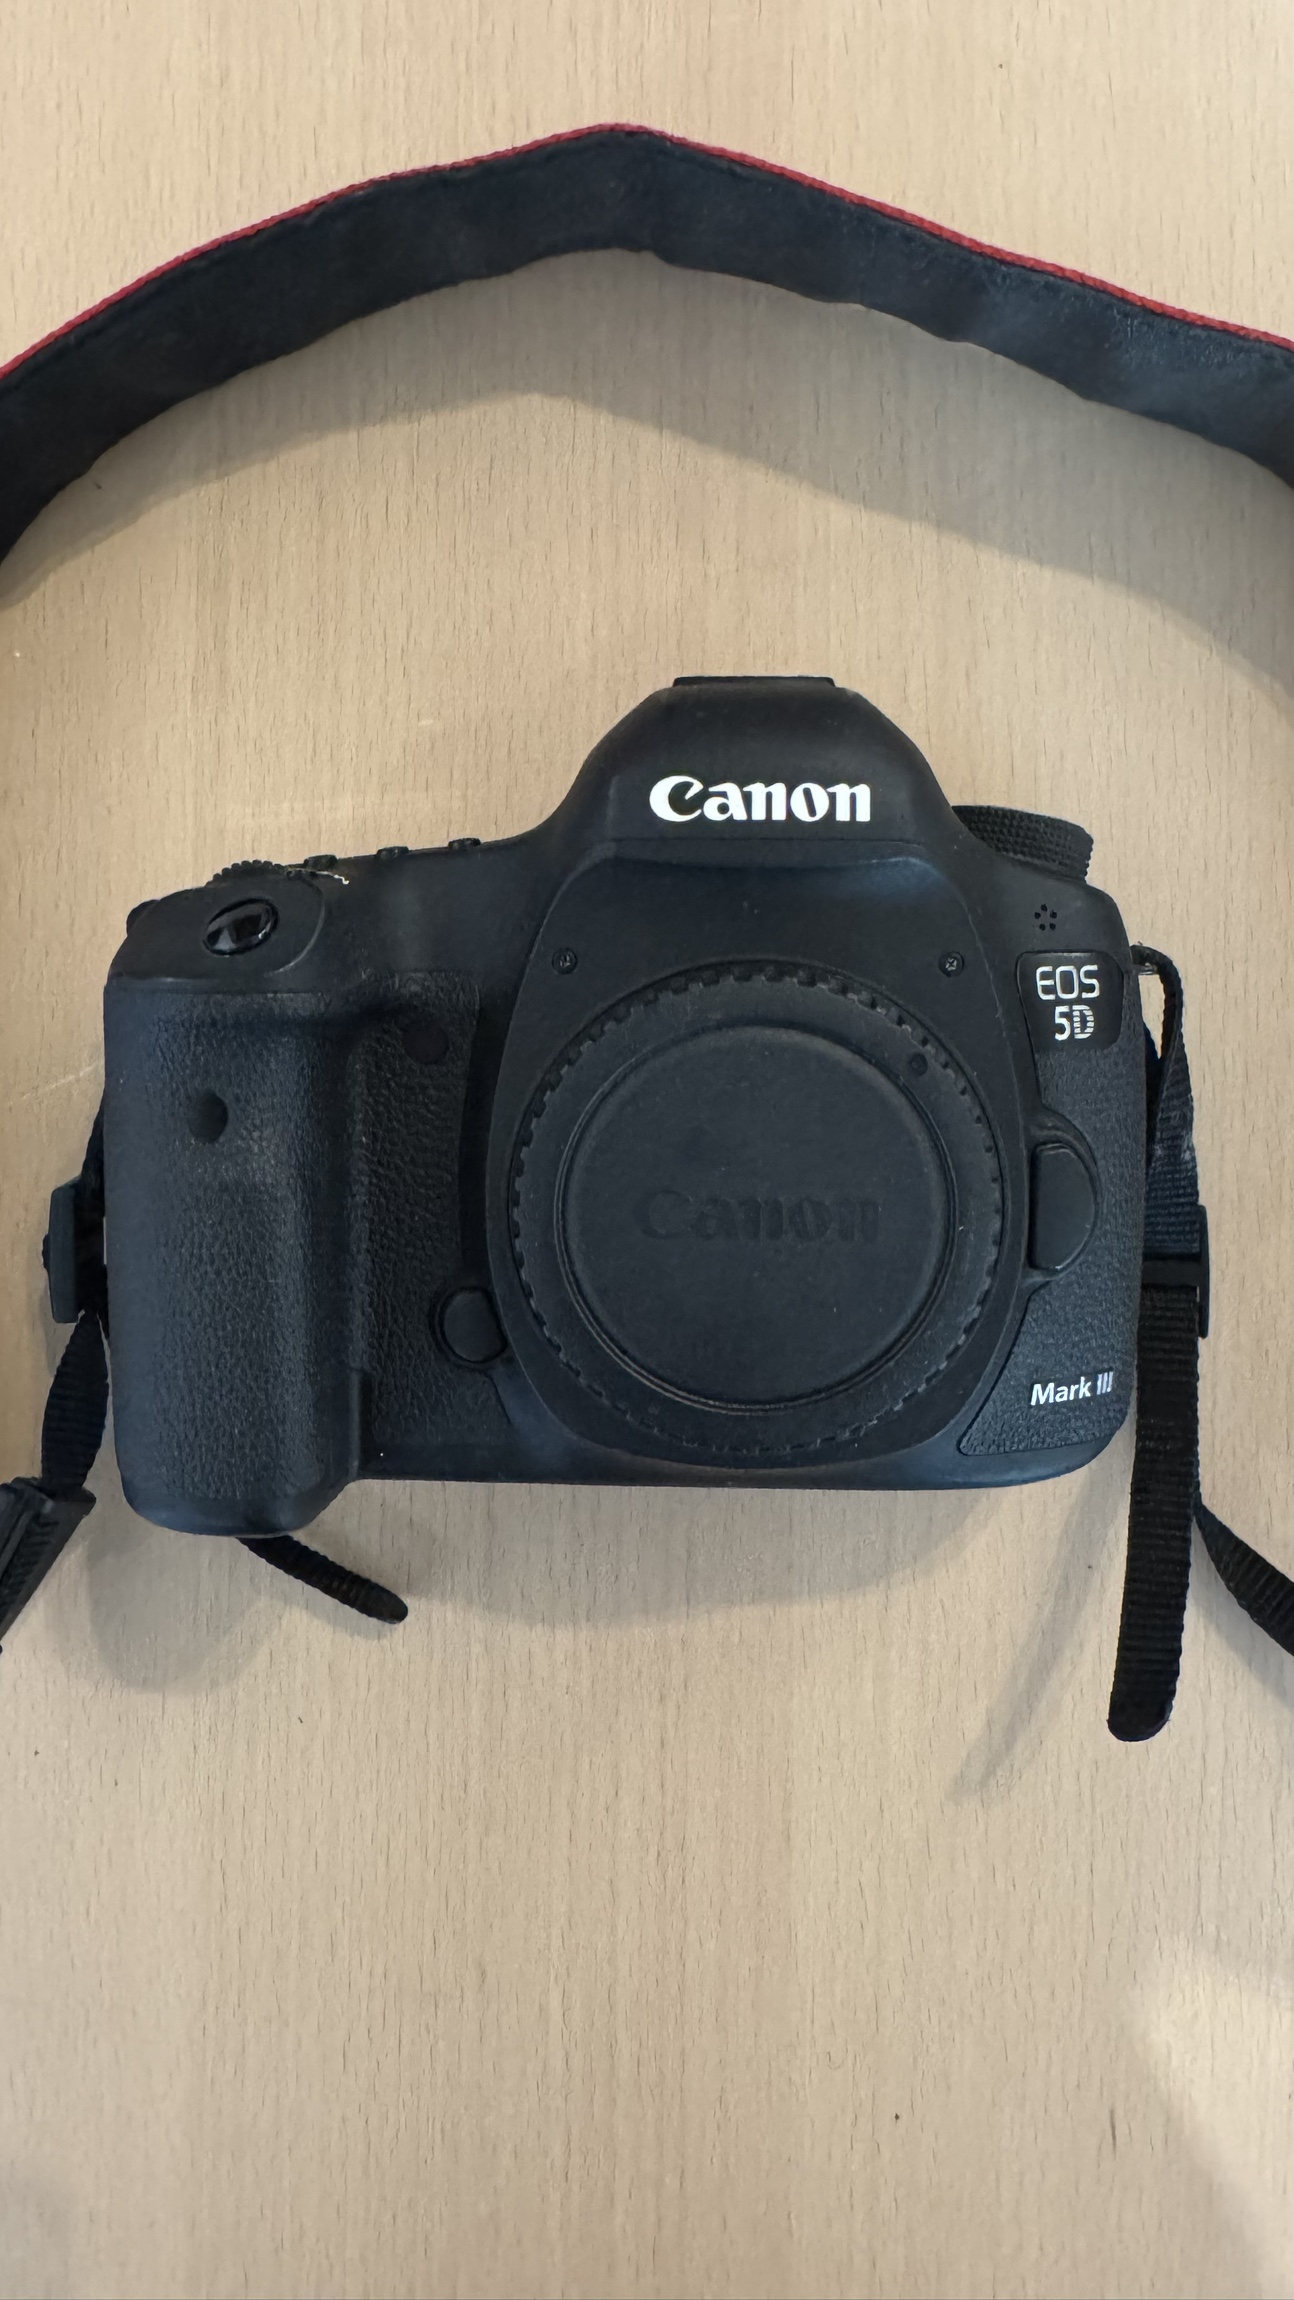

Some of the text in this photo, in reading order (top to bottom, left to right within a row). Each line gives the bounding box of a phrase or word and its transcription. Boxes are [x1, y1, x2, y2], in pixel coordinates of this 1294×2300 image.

[649, 775, 871, 822] Canon
[1035, 964, 1100, 1001] EOS
[1054, 1004, 1095, 1041] 5D
[633, 1189, 879, 1241] Canon
[1030, 1371, 1114, 1406] Mark III
